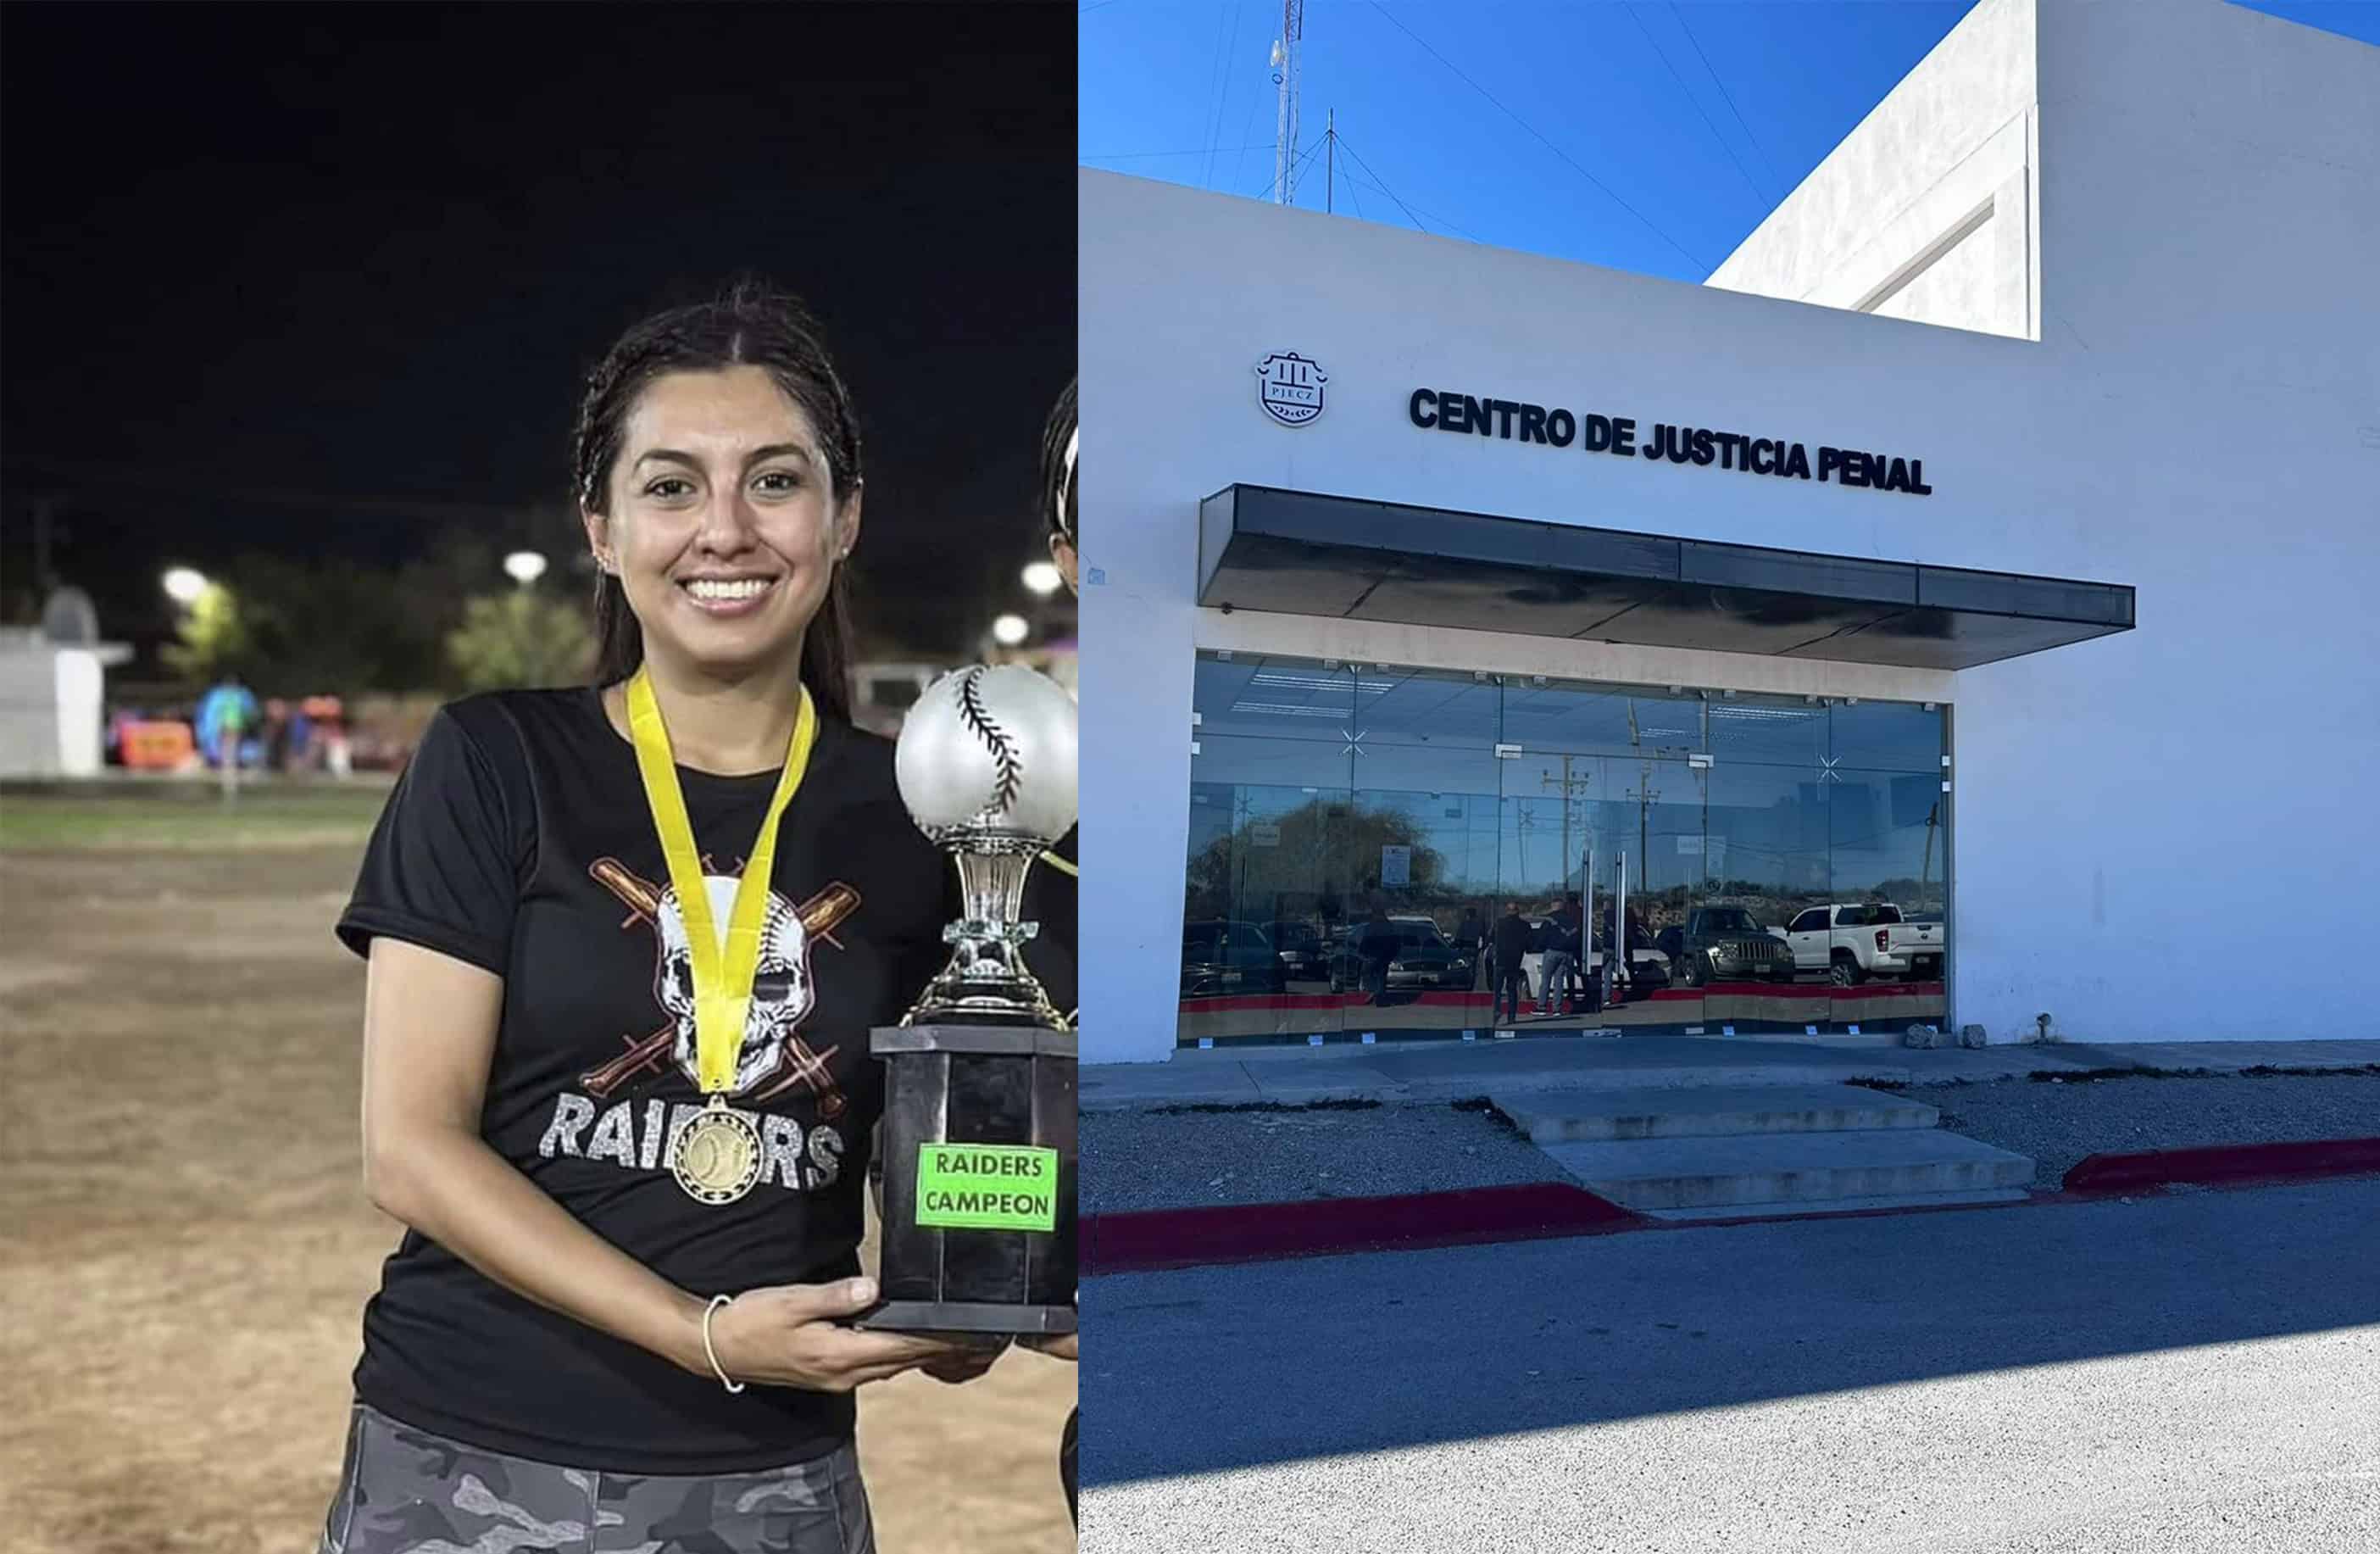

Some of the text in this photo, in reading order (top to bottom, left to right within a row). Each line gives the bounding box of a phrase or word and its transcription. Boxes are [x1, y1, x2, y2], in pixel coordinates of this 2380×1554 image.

[1410, 387, 1932, 496] CENTRO DE JUSTICIA PENAL
[538, 1092, 844, 1190] RAIRS
[936, 1152, 1043, 1177] RAIDERS
[926, 1191, 1048, 1215] CAMPEON
